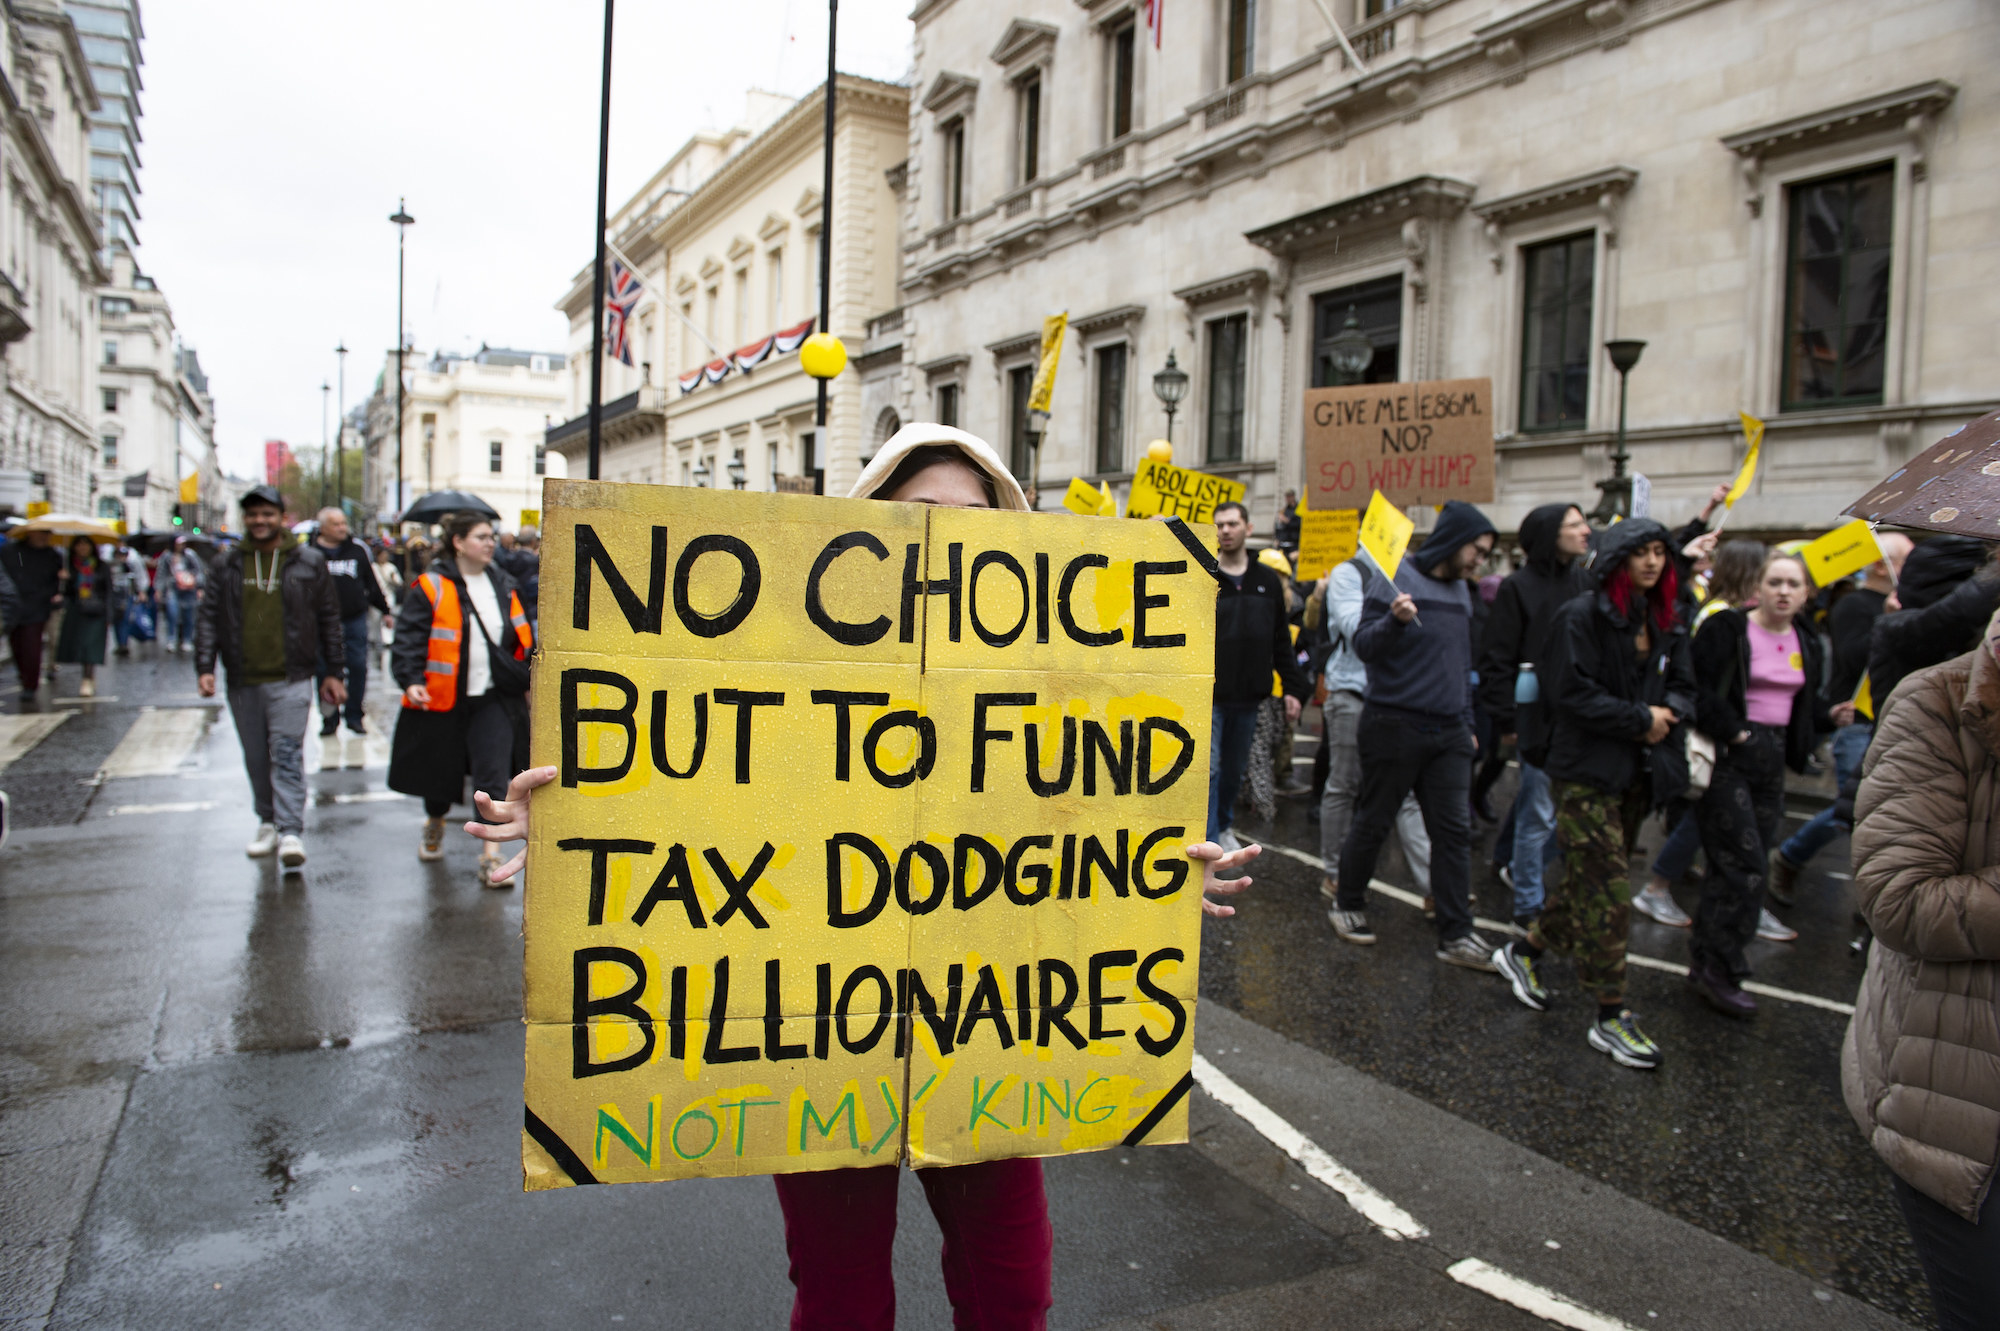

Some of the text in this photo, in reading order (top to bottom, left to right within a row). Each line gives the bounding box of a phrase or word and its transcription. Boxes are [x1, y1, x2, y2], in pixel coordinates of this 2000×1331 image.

[1314, 399, 1367, 426] GIVE
[1375, 396, 1409, 424] ME
[1381, 424, 1433, 454] NO?
[1142, 463, 1232, 503] ABOLISH
[1318, 453, 1477, 492] SO WHY HIM?
[1157, 491, 1212, 524] THE
[572, 523, 1188, 649] NO CHOICE
[560, 668, 1195, 798] BUT TO FUND
[556, 826, 1190, 930] TAX DODGING
[572, 946, 1188, 1080] BILLIONAIRES
[594, 1074, 1118, 1169] NOT MY KING
